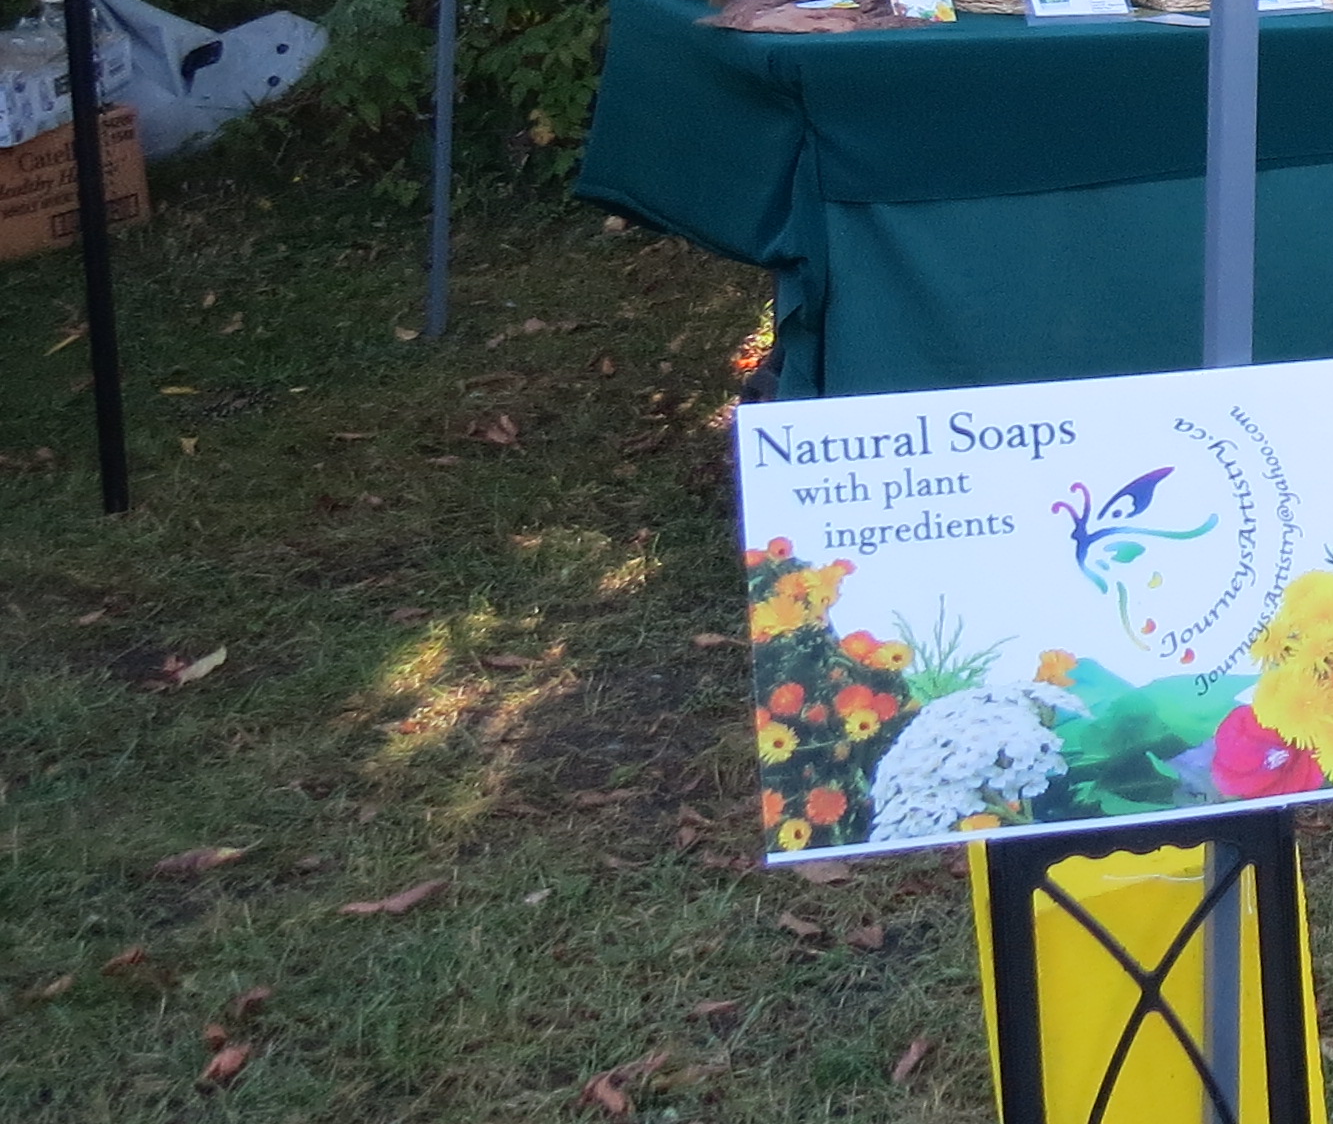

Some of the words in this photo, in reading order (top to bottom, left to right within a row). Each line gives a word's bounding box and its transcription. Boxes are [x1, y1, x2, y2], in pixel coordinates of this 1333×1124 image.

[753, 414, 933, 468] Natural
[948, 411, 1077, 461] Soaps
[793, 472, 872, 506] with
[882, 467, 973, 510] plant
[824, 510, 1015, 555] ingredients
[1159, 416, 1257, 658] JourneysArtistry.ca
[1194, 405, 1303, 697] Journeys.Artistry@yahoo.com
